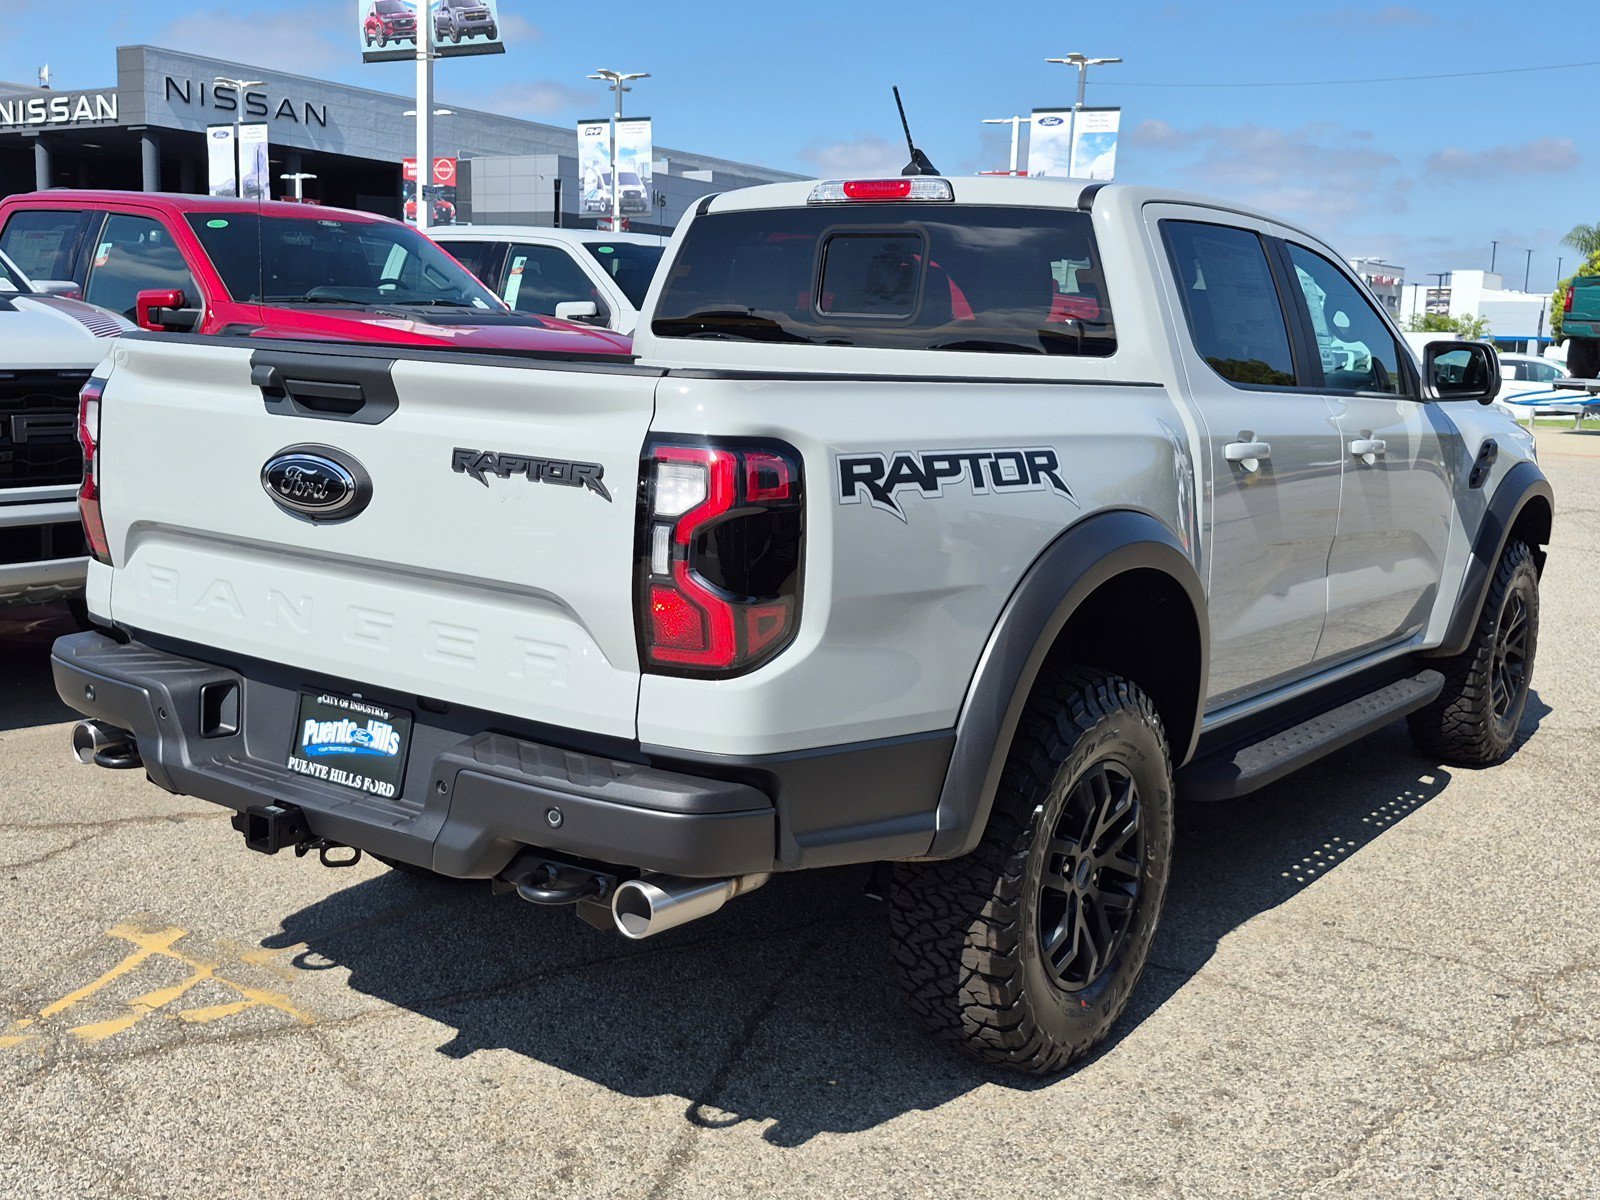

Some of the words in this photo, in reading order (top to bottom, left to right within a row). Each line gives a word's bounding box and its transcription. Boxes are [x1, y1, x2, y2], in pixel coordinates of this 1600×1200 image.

[0, 94, 117, 124] NISSAN
[165, 76, 326, 127] NISSAN
[281, 465, 329, 499] Ford
[452, 447, 612, 503] RAPTOR
[835, 446, 1080, 525] RAPTOR
[142, 563, 572, 686] RANGER
[322, 694, 339, 706] CITY
[340, 698, 349, 708] OF
[349, 700, 385, 716] INDUSTRY
[303, 719, 357, 746] Puente
[366, 720, 400, 755] Hills
[288, 757, 328, 779] PUENTE
[329, 767, 362, 789] HILLS
[363, 777, 395, 797] FORD
